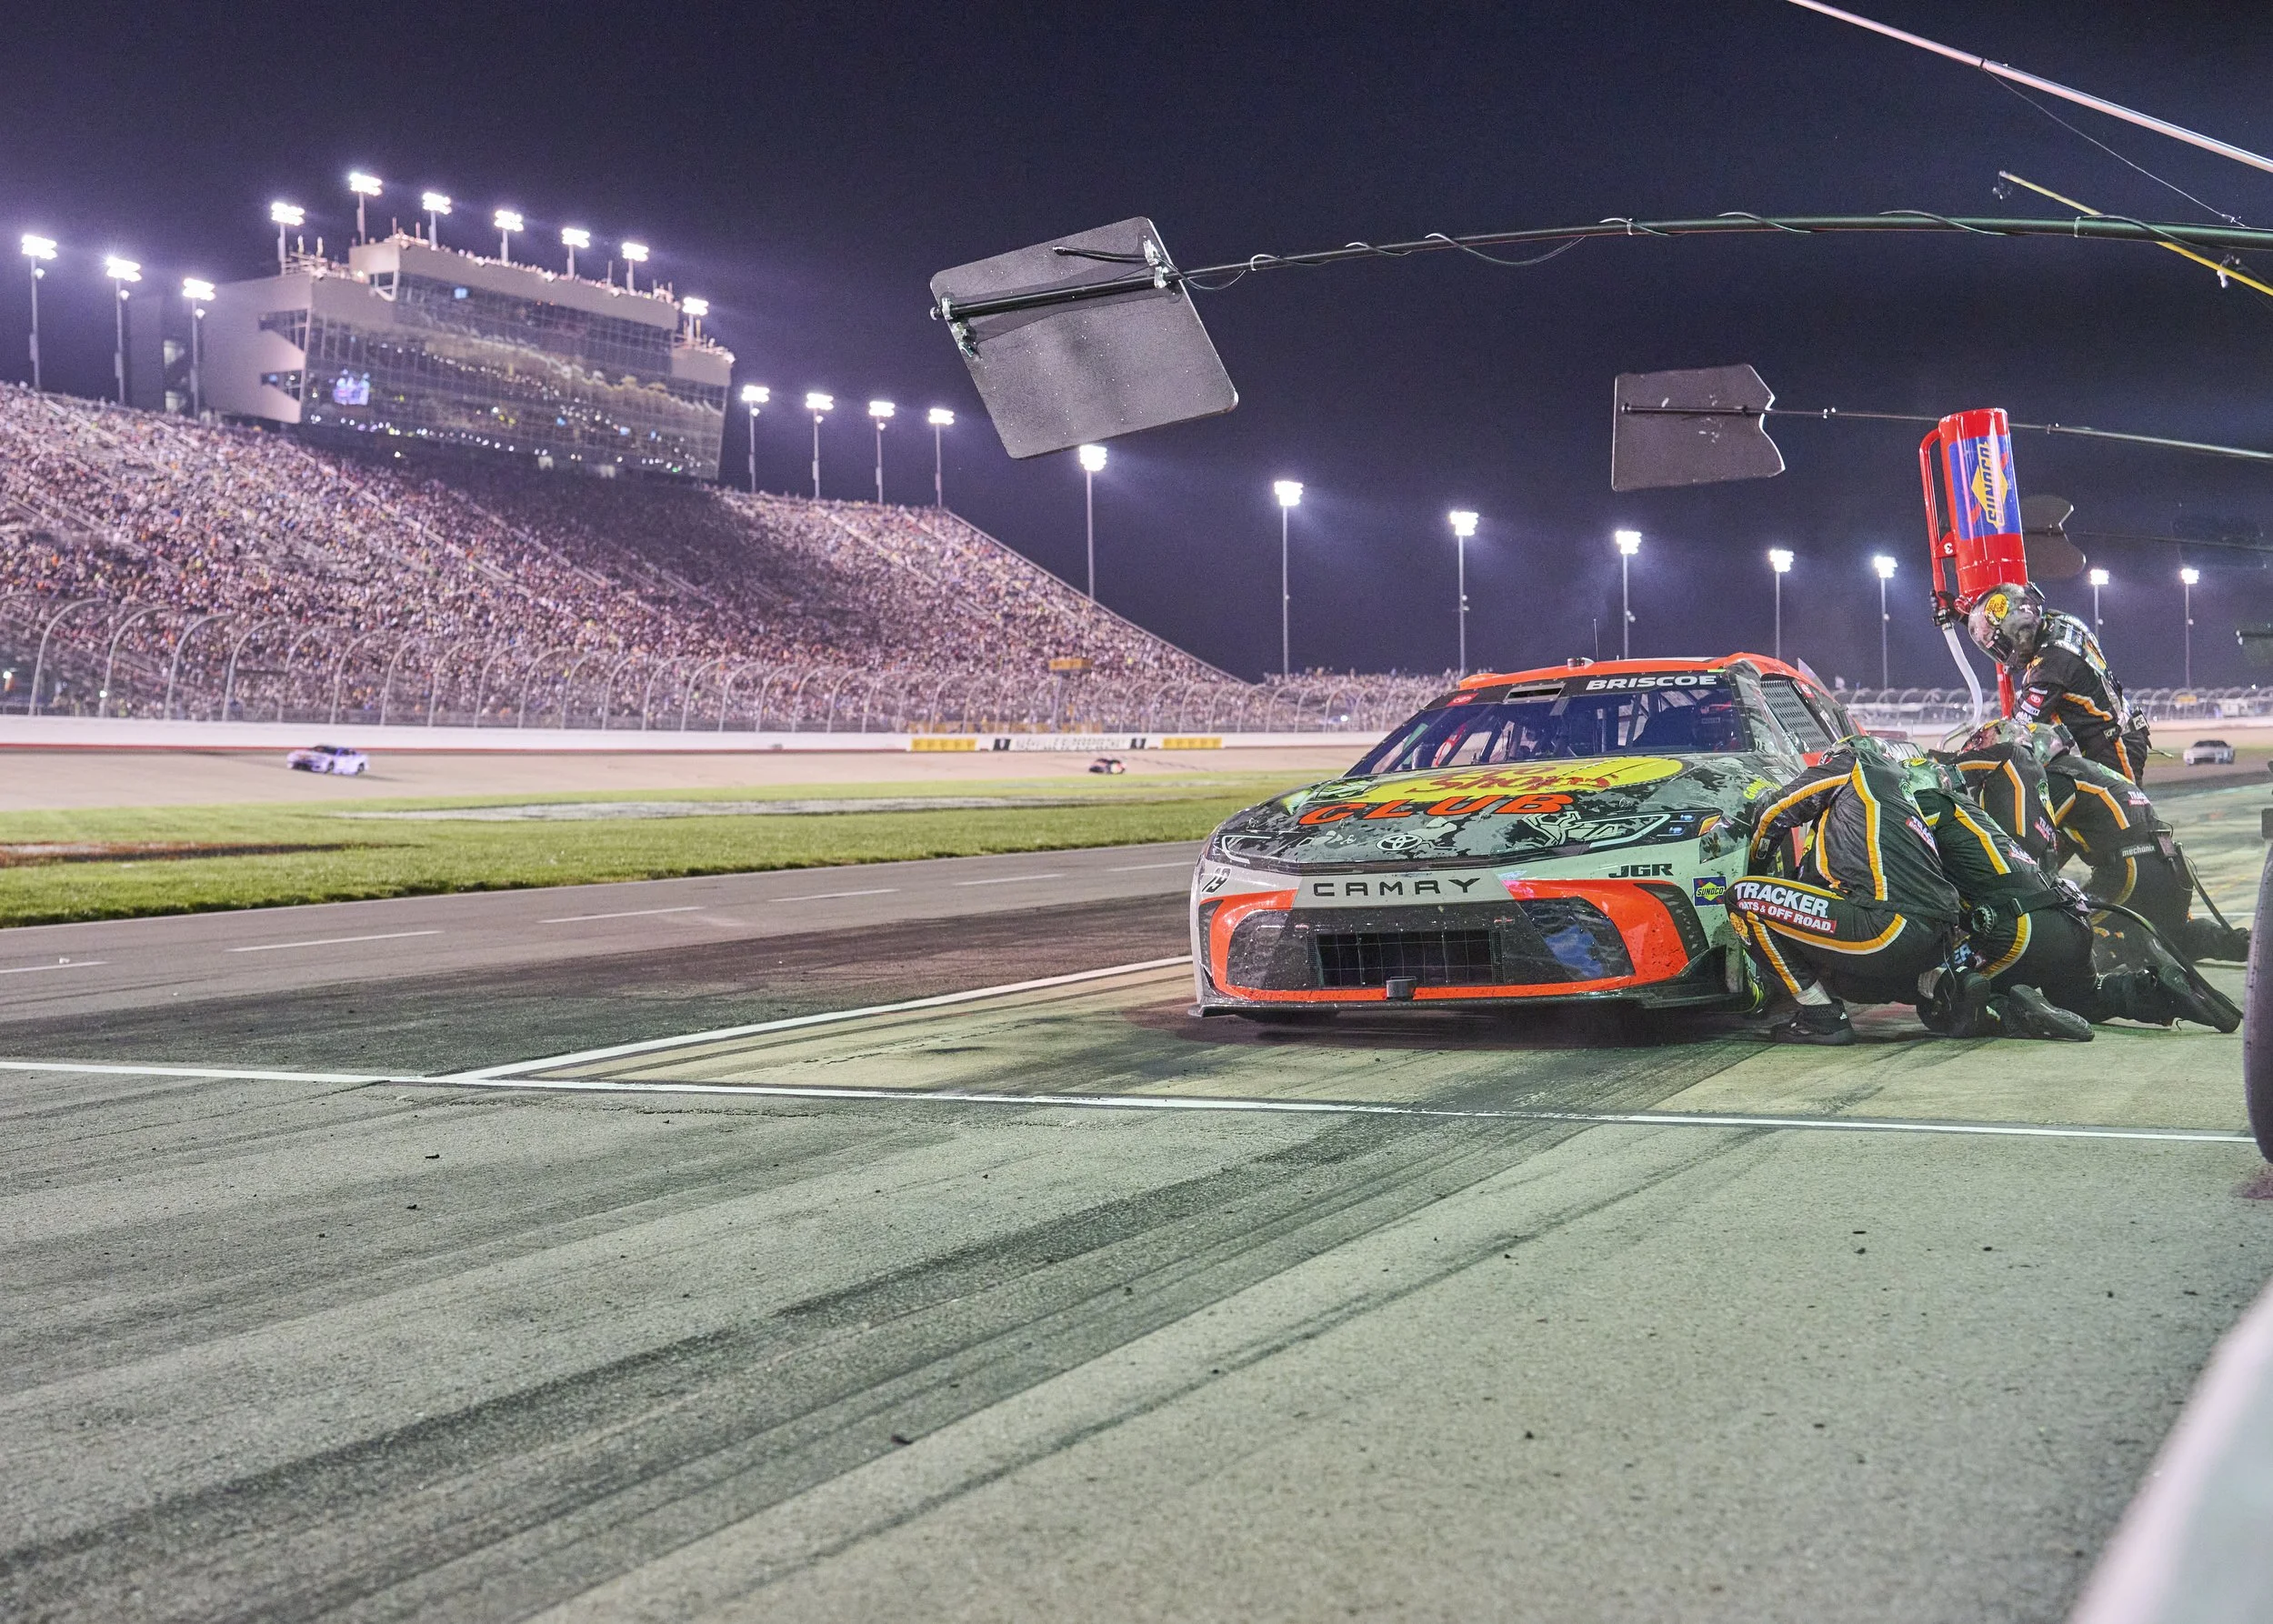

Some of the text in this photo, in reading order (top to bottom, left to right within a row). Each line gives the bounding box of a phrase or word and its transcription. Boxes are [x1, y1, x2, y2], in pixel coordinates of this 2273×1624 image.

[1978, 445, 2005, 525] SUNOCO
[1585, 675, 1717, 691] BRISCOE
[1299, 794, 1574, 825] CLUB
[2122, 844, 2155, 857] mechanix
[1202, 867, 1231, 893] 19
[1608, 864, 1674, 878] JGR
[1314, 877, 1481, 897] CAMRY
[1697, 887, 1724, 896] SUNOCO
[1735, 882, 1829, 917] TRACKER
[1738, 899, 1831, 932] OATS & OFF ROAD
